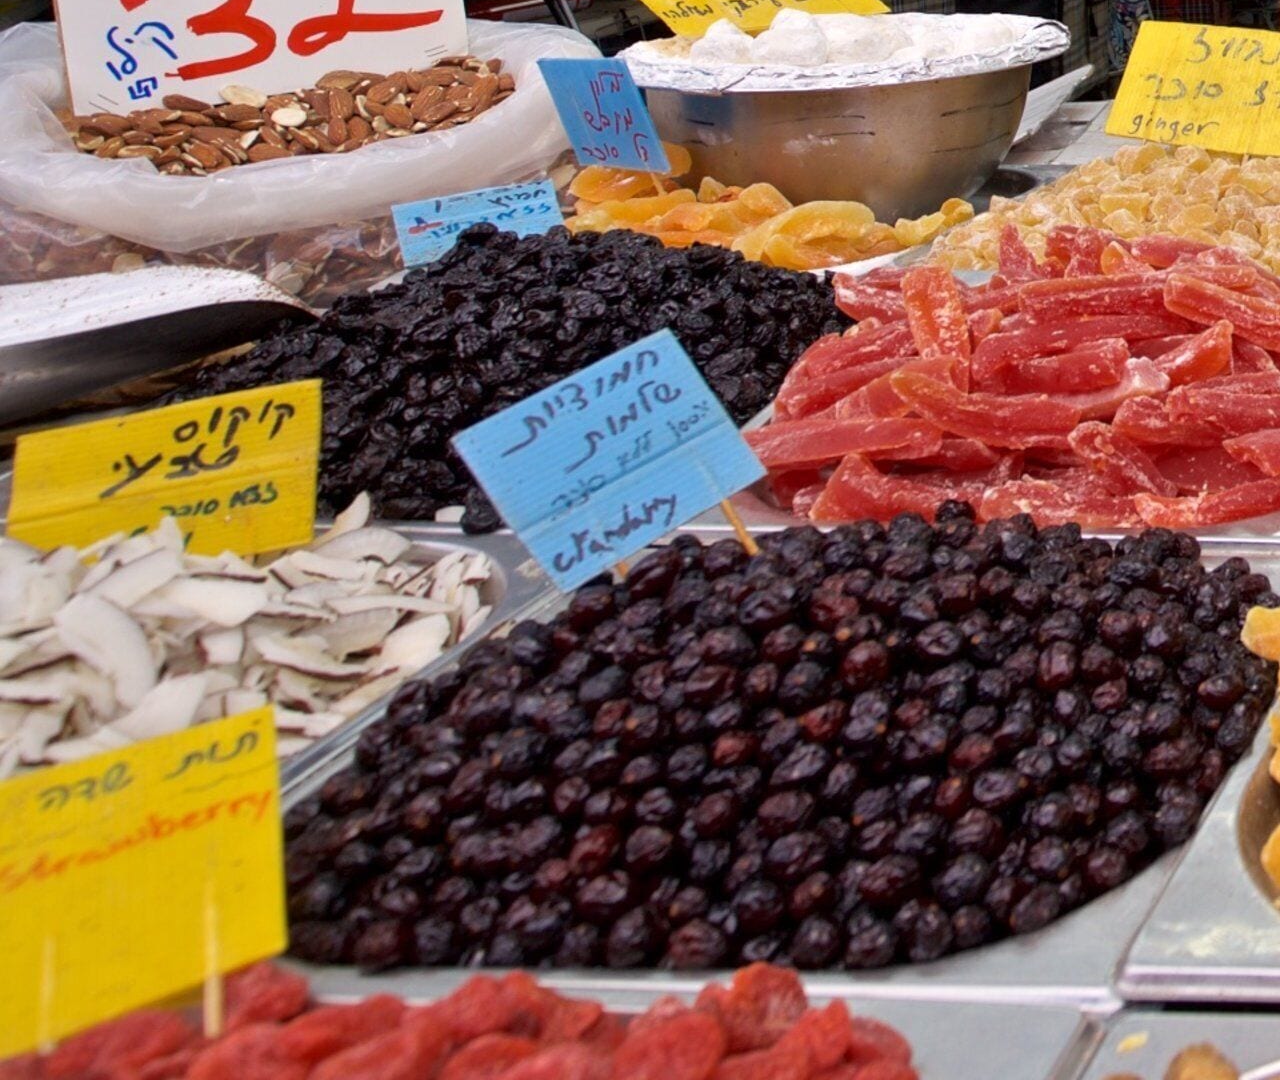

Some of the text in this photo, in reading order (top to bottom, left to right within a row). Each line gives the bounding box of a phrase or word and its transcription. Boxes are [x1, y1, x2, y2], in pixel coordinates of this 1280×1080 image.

[1128, 112, 1220, 142] ginger
[172, 399, 296, 448] קוקוס
[36, 760, 136, 812] שדה
